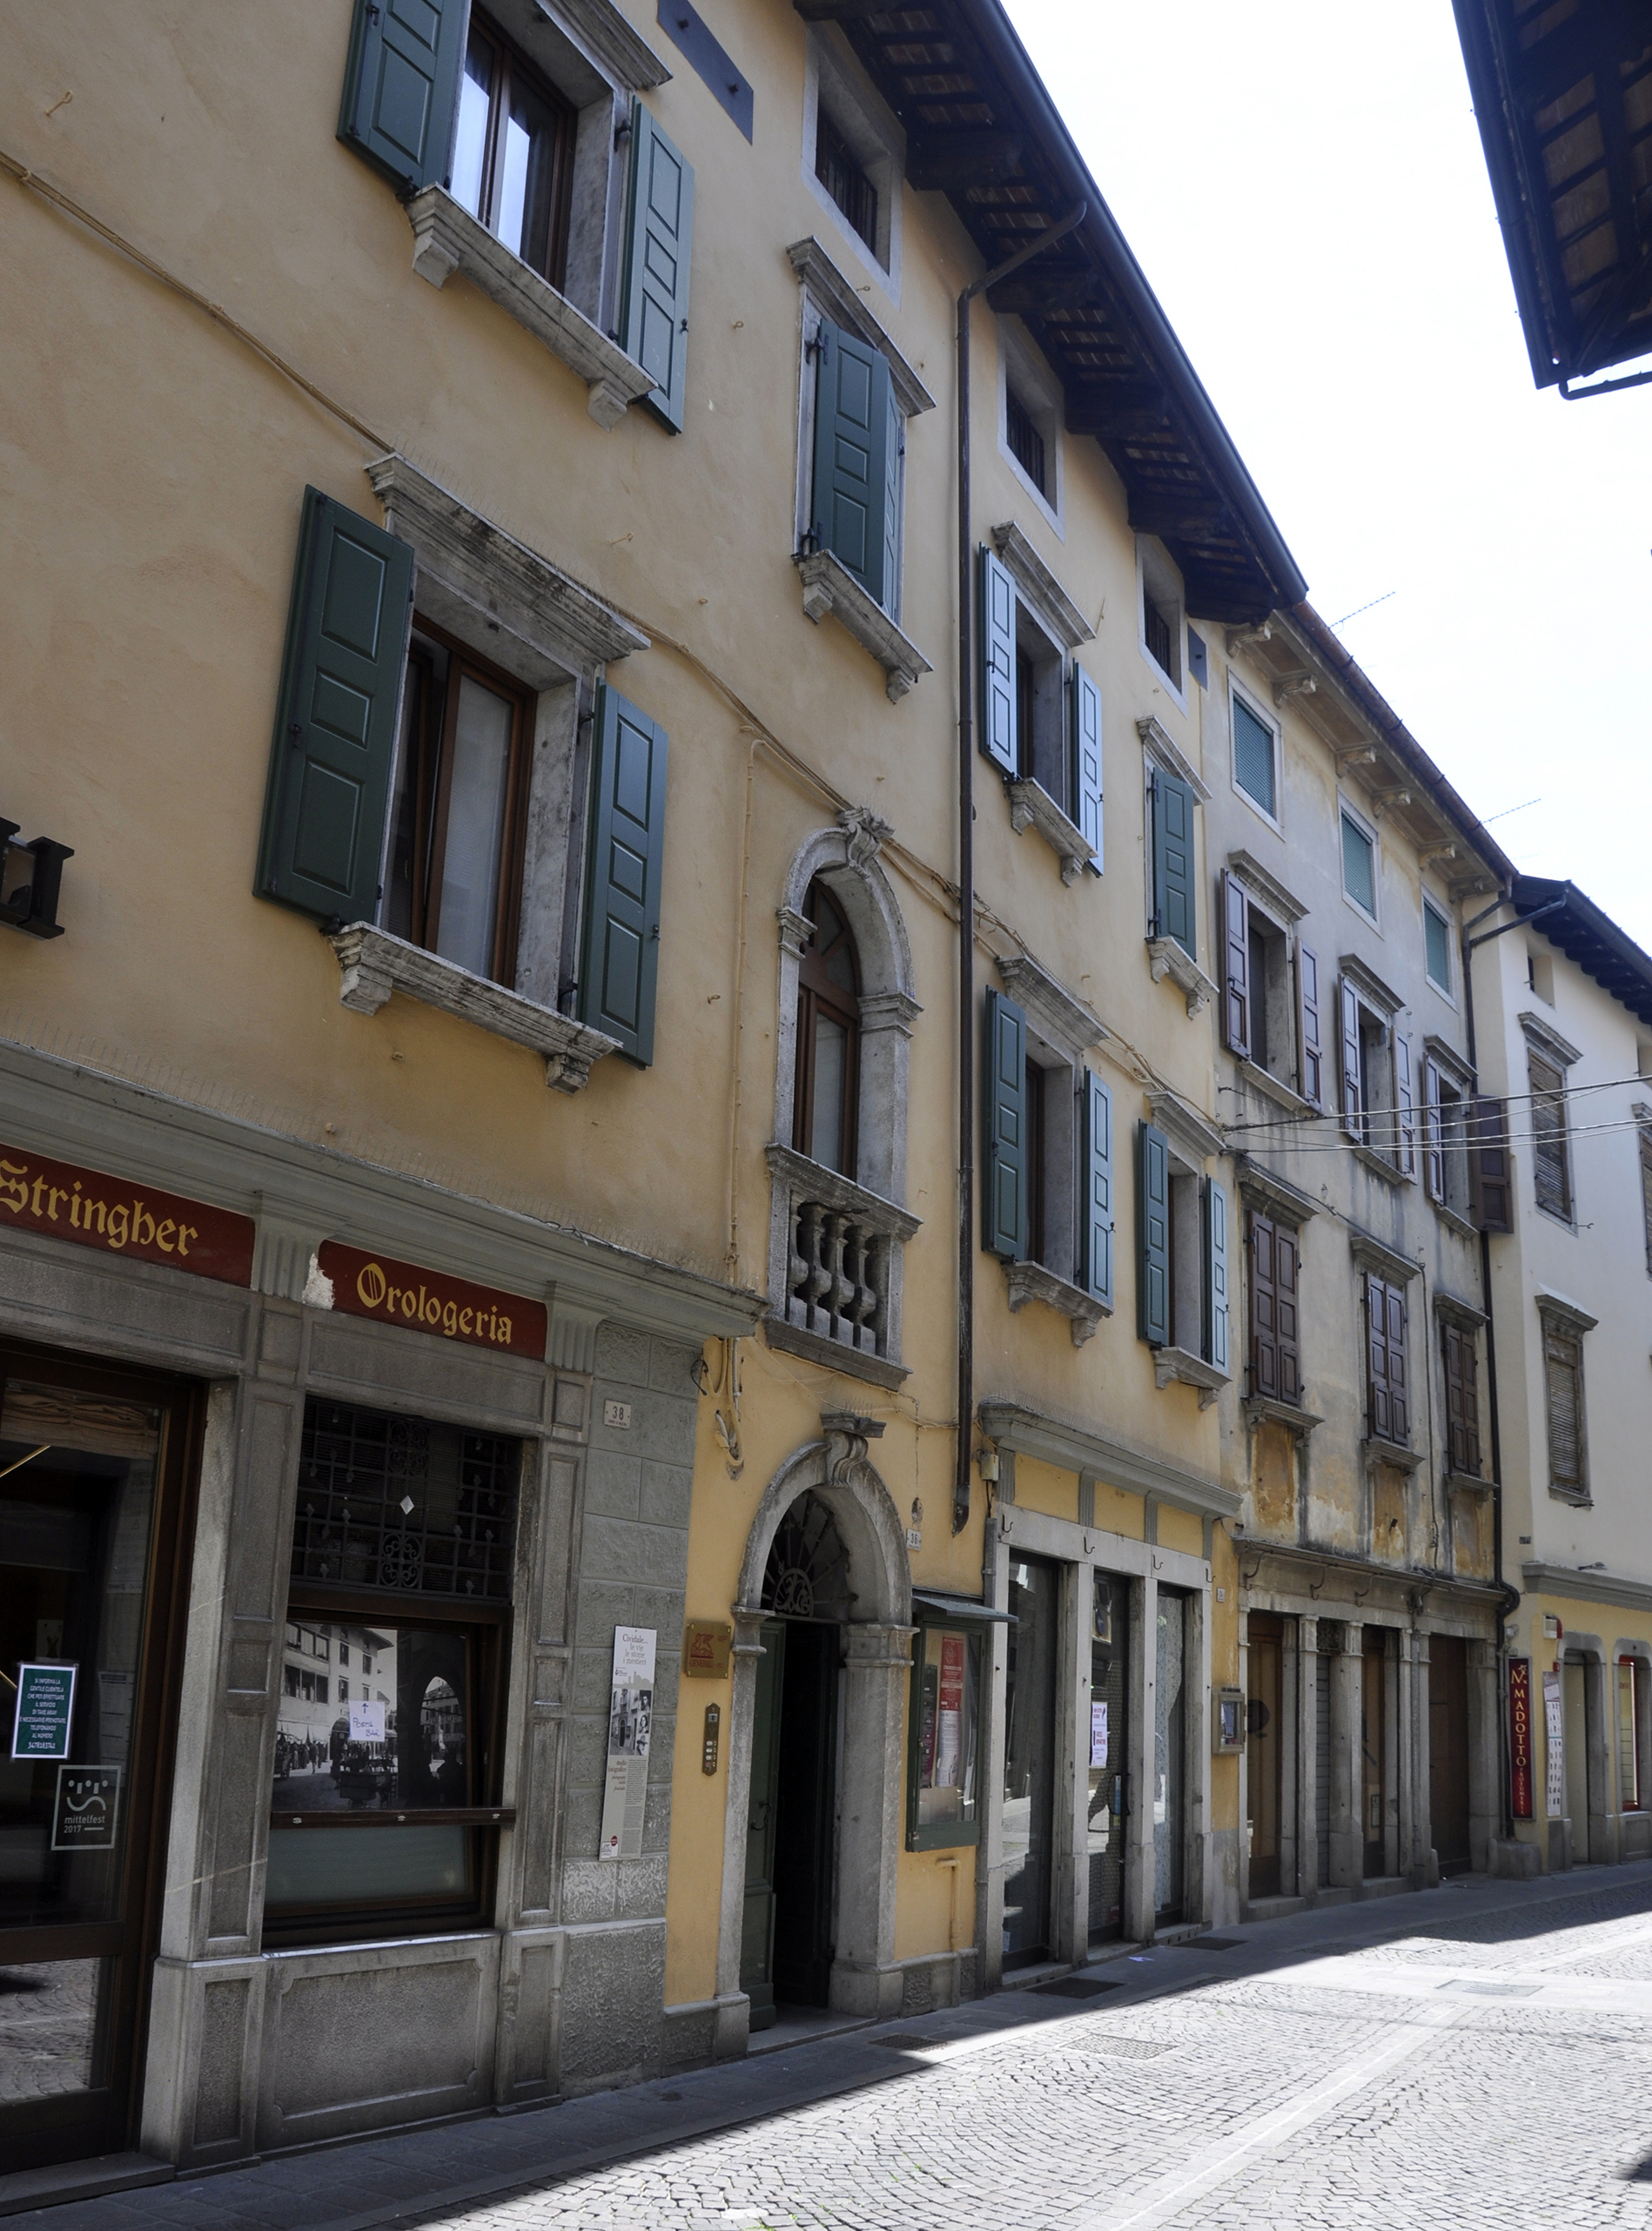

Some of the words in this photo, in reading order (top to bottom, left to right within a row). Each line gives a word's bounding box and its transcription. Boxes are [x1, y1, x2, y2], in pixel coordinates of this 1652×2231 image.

[0, 1159, 198, 1256] Stringher
[357, 1263, 512, 1344] Orologeria
[613, 1406, 624, 1421] 38
[910, 1533, 918, 1544] 36
[1514, 1689, 1527, 1767] MADOTTO
[64, 1815, 105, 1824] mittelfest
[64, 1824, 81, 1833] 2017
